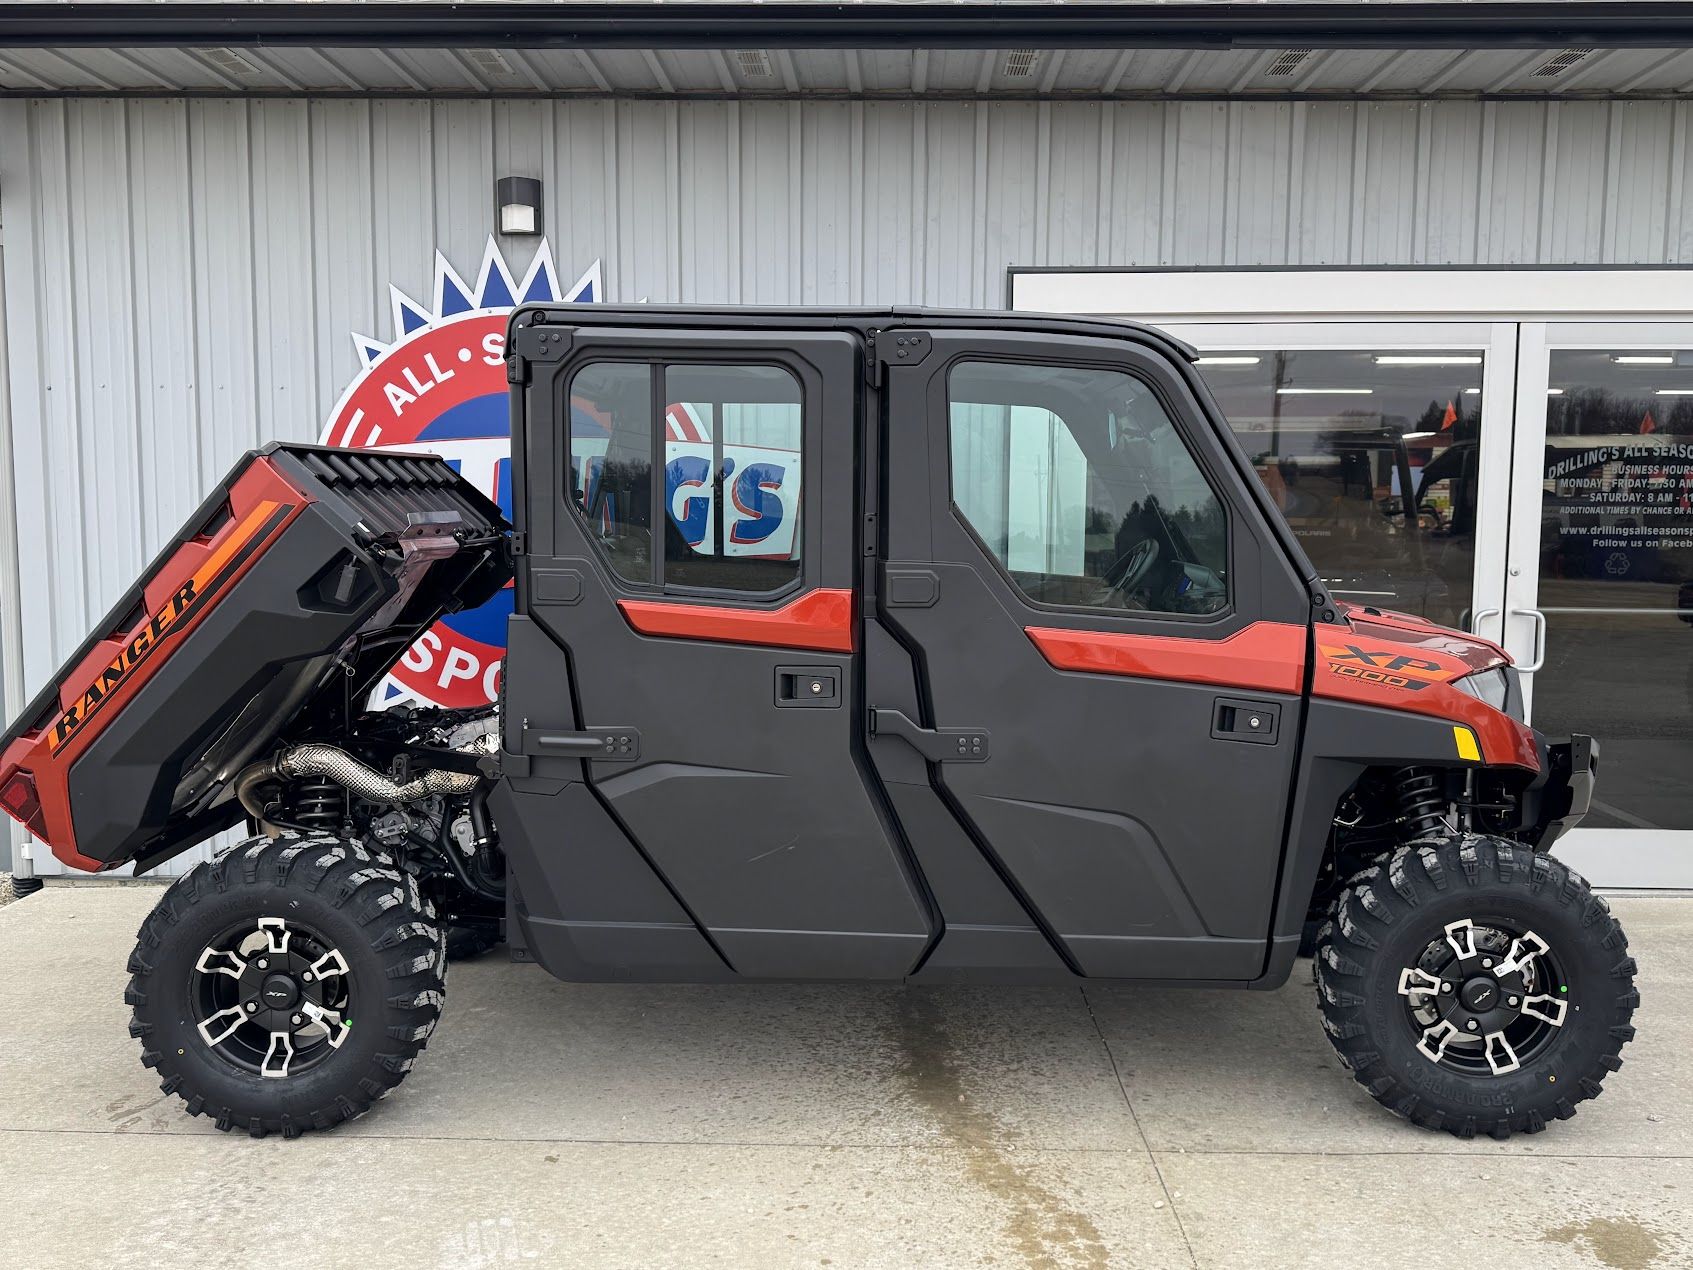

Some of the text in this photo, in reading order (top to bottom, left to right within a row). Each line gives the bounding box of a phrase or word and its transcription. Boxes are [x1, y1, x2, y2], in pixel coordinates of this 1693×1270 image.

[383, 352, 456, 417] ALL
[1548, 446, 1620, 480] DRILLING'S
[1624, 444, 1649, 458] ALL
[1612, 464, 1660, 475] BUSINESS
[1560, 478, 1601, 489] MONDAY
[1590, 492, 1645, 503] SATURDAY:
[1647, 492, 1654, 502] 8
[1656, 493, 1673, 502] AM
[1559, 506, 1693, 515] ADDITIONAL TIMES BY CHANCE OR A
[1592, 539, 1627, 548] Follow
[1630, 540, 1643, 548] us
[1645, 540, 1659, 548] on
[55, 579, 197, 743] RANGER
[1329, 644, 1442, 671] XP
[1328, 662, 1409, 687] 1000
